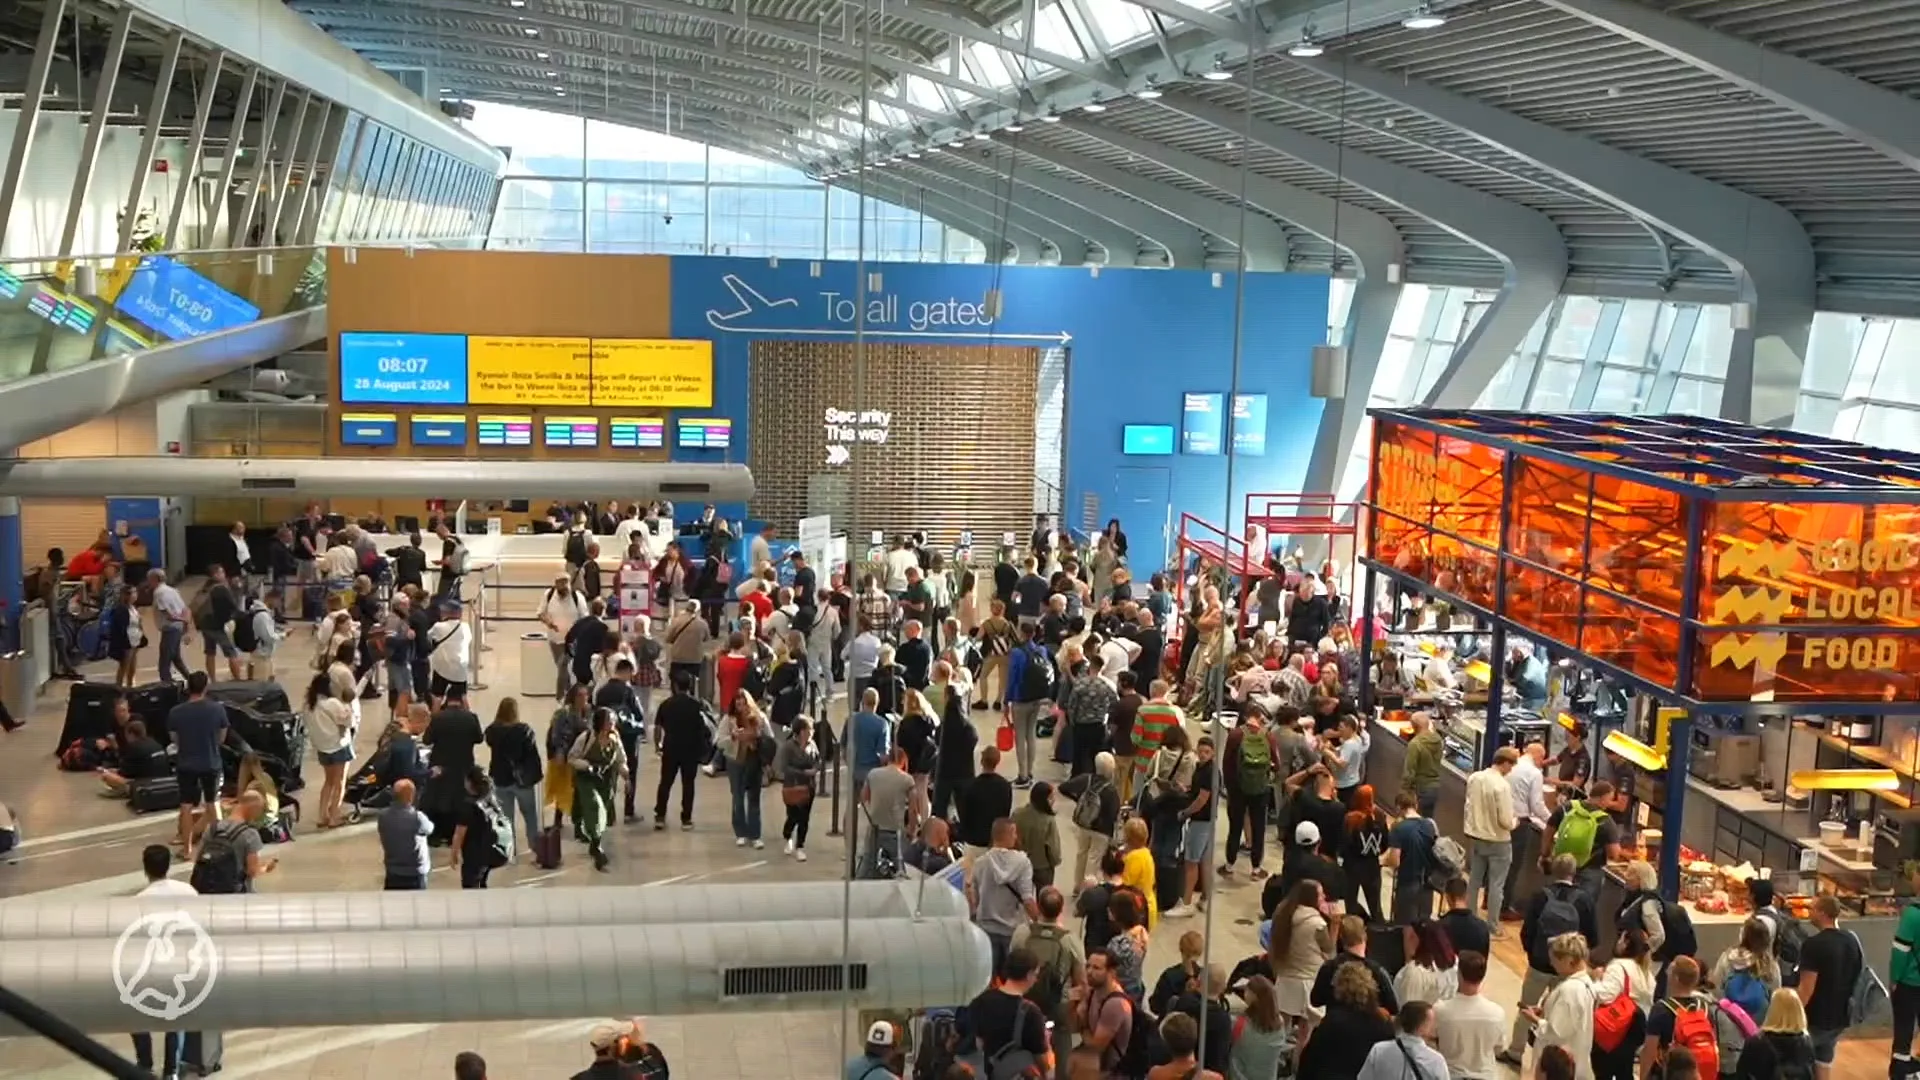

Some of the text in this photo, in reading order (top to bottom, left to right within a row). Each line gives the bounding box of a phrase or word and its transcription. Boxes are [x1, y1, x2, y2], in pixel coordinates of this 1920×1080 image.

[819, 291, 856, 322] To
[867, 294, 897, 322] all
[378, 357, 428, 373] 08:07
[373, 378, 417, 393] August
[419, 379, 450, 391] 2024
[480, 382, 494, 391] the
[497, 382, 513, 391] bus
[515, 383, 525, 391] to
[599, 384, 611, 393] be
[612, 384, 636, 395] ready
[674, 385, 700, 394] under
[628, 374, 656, 384] depart
[824, 407, 892, 427] Security
[824, 425, 889, 443] This way
[1811, 538, 1909, 572] GOOD
[1807, 586, 1920, 620] LOCAL
[1802, 637, 1899, 670] FOOD
